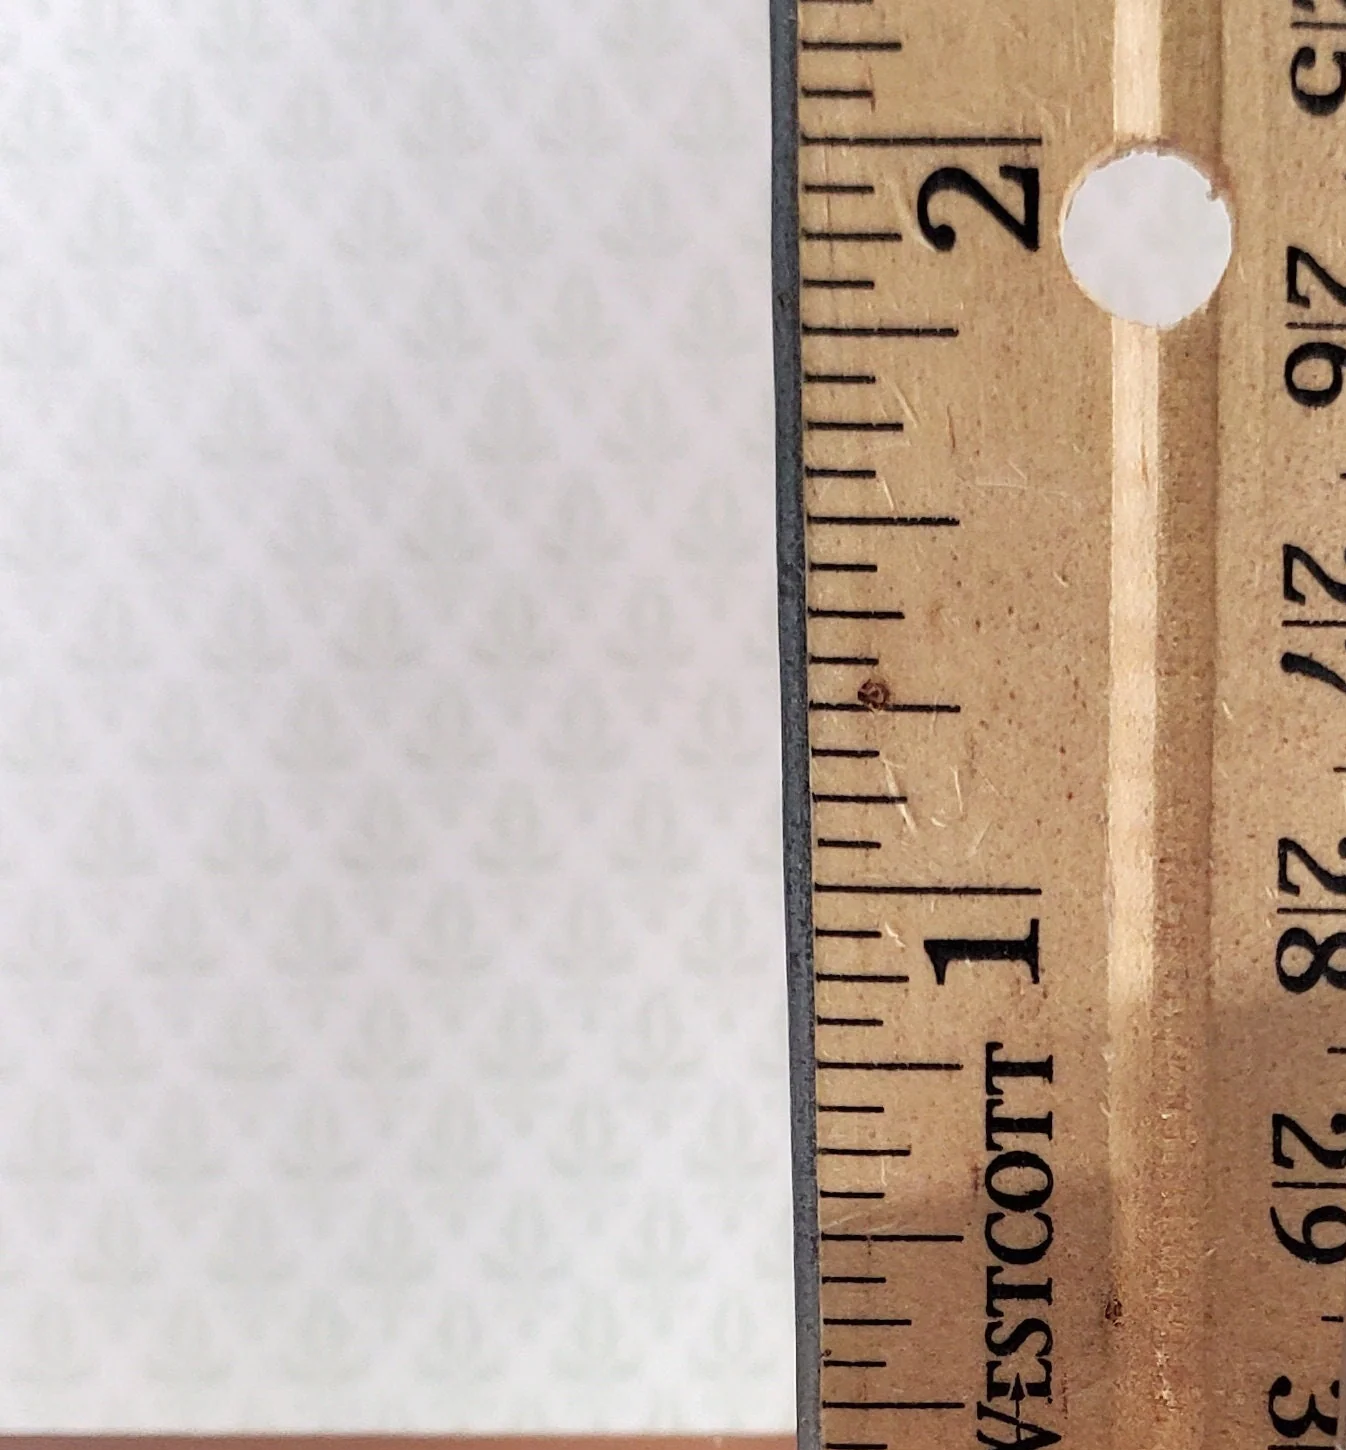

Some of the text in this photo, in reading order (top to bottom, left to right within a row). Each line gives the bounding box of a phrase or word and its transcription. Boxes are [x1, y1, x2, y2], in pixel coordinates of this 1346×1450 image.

[917, 165, 1040, 253] 2
[923, 918, 1041, 985] 1
[1268, 1375, 1340, 1438] 3
